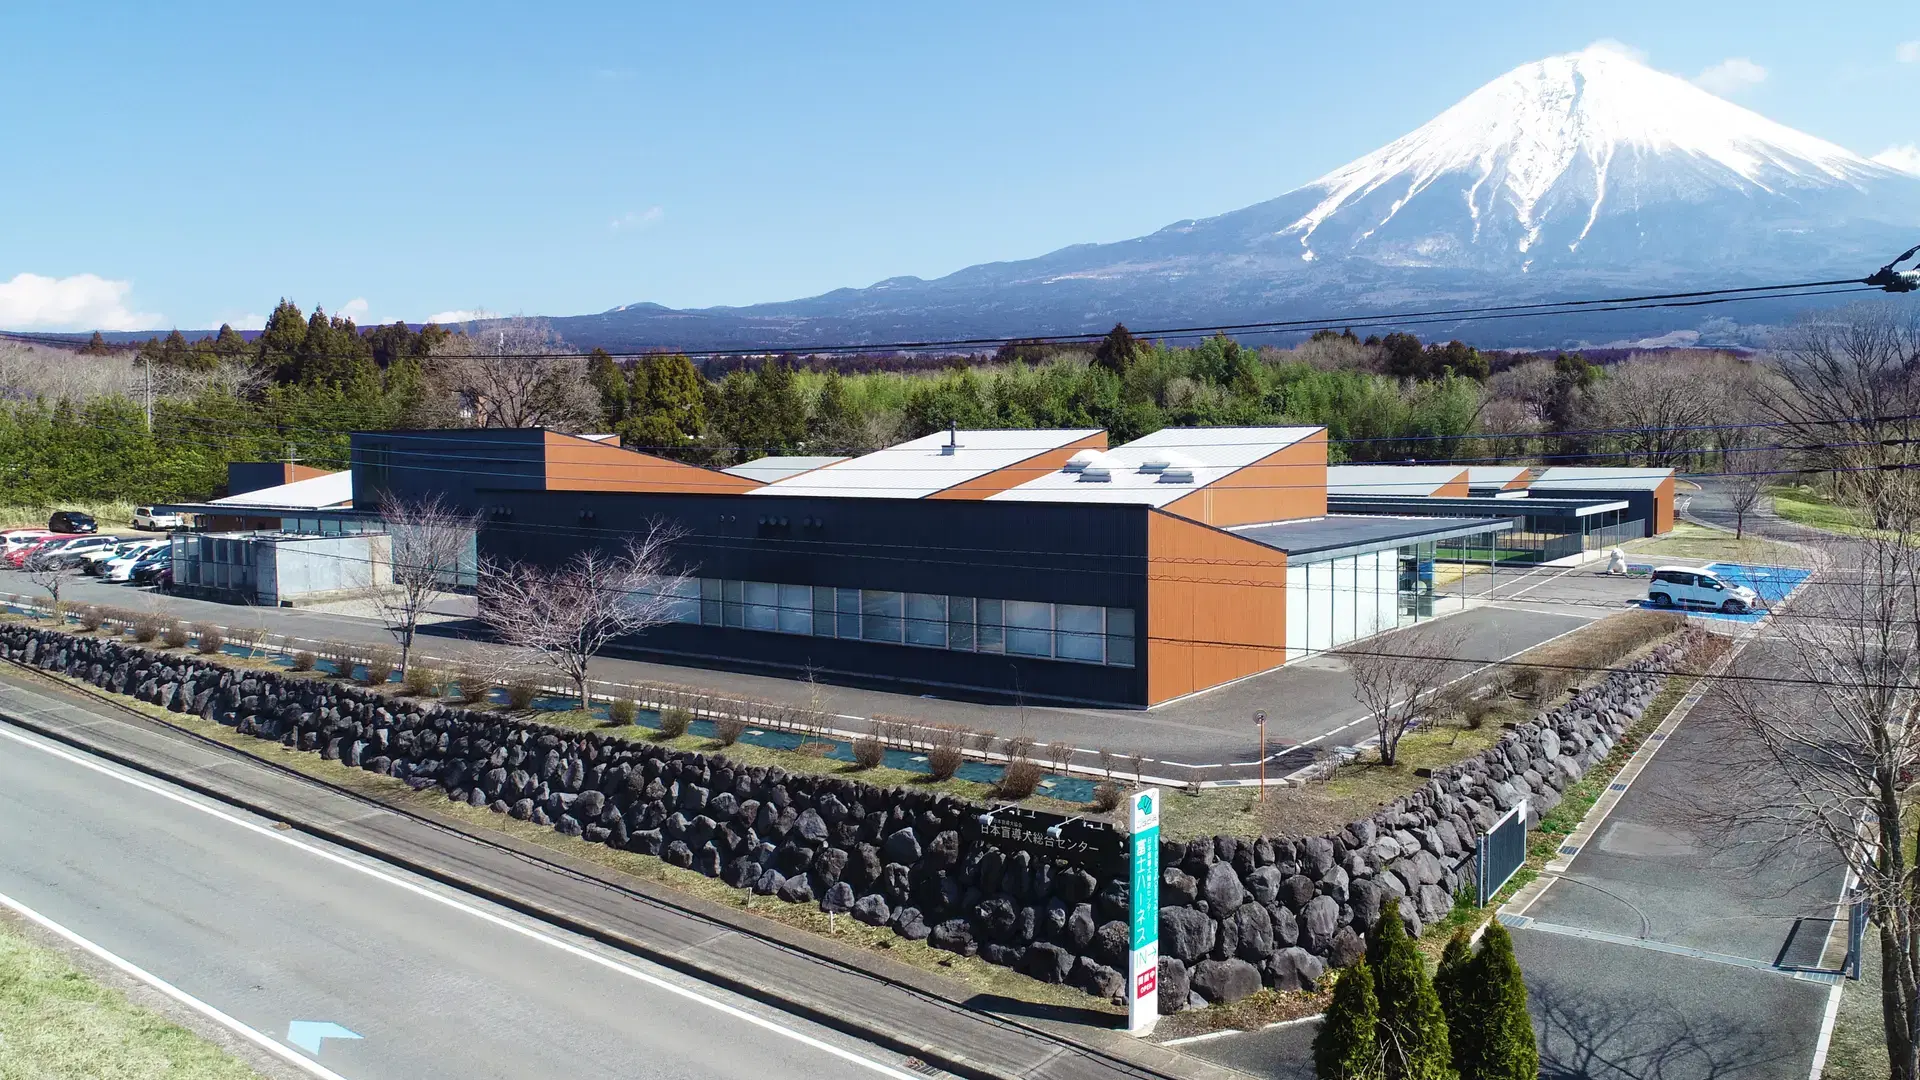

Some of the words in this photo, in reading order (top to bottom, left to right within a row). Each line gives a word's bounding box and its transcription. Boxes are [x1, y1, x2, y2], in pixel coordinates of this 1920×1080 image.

[981, 824, 1099, 853] 日本盲導犬総合センター
[1136, 949, 1147, 968] IN
[1140, 982, 1153, 994] OPEN
